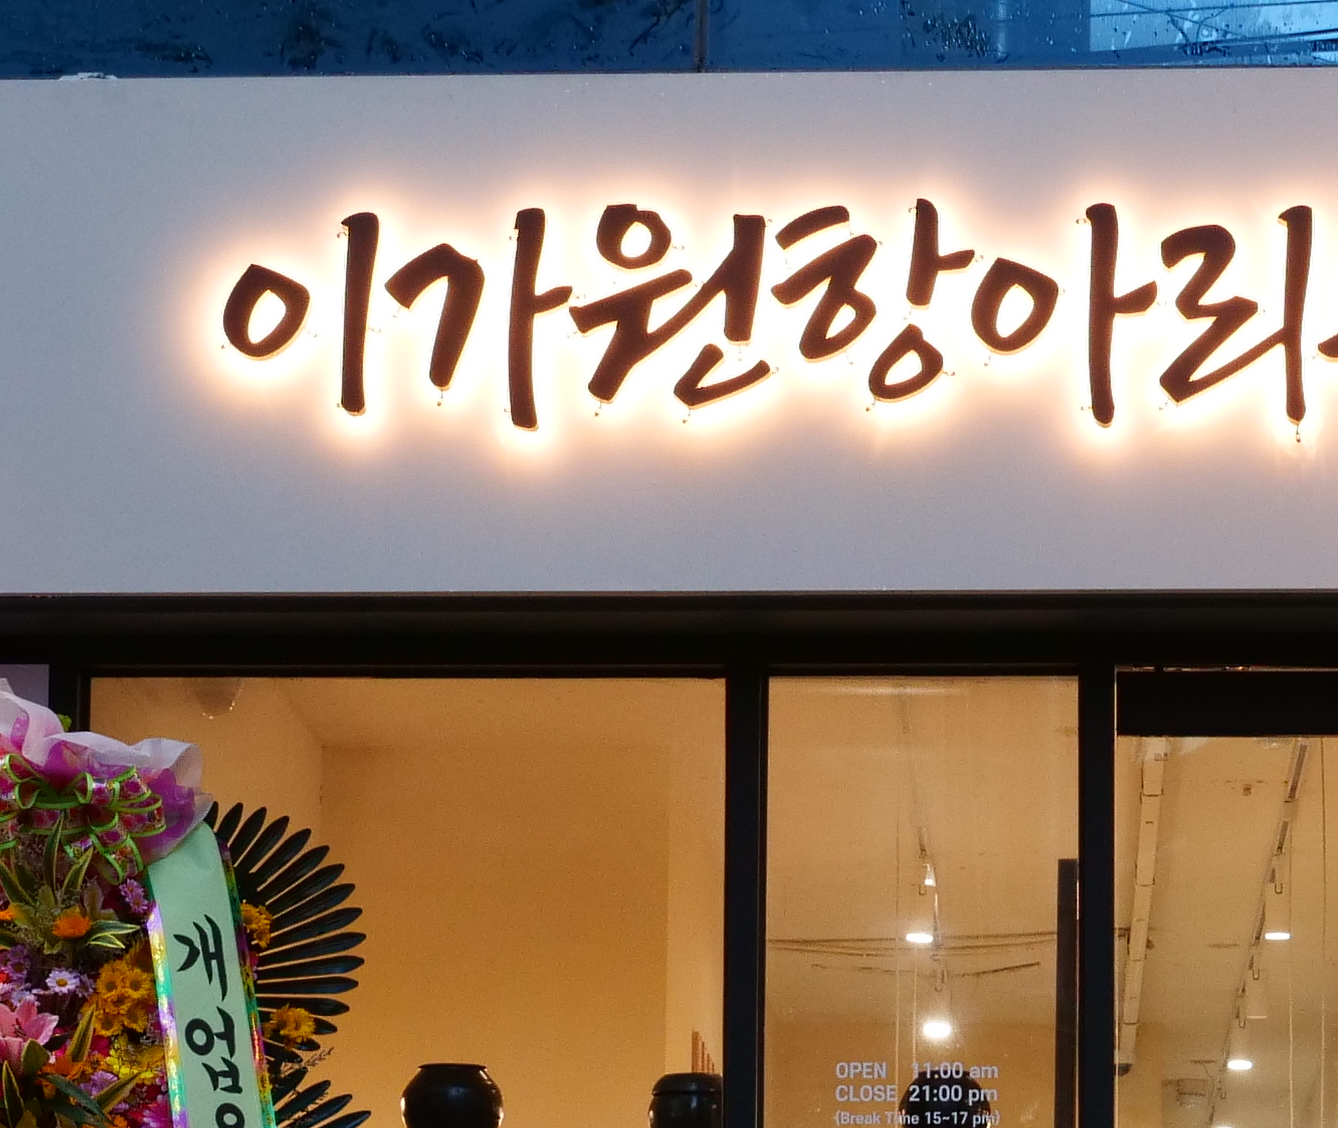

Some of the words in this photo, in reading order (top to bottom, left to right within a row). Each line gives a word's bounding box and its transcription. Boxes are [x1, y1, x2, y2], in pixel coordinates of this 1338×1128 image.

[835, 1062, 887, 1079] OPEN
[912, 1062, 963, 1079] 11:00
[969, 1065, 999, 1079] am
[835, 1085, 898, 1102] CLOSE
[909, 1085, 963, 1102] 21:00
[968, 1088, 998, 1105] pm
[835, 1110, 881, 1126] (Break
[885, 1112, 920, 1125] Time
[972, 1110, 1001, 1127] pm)
